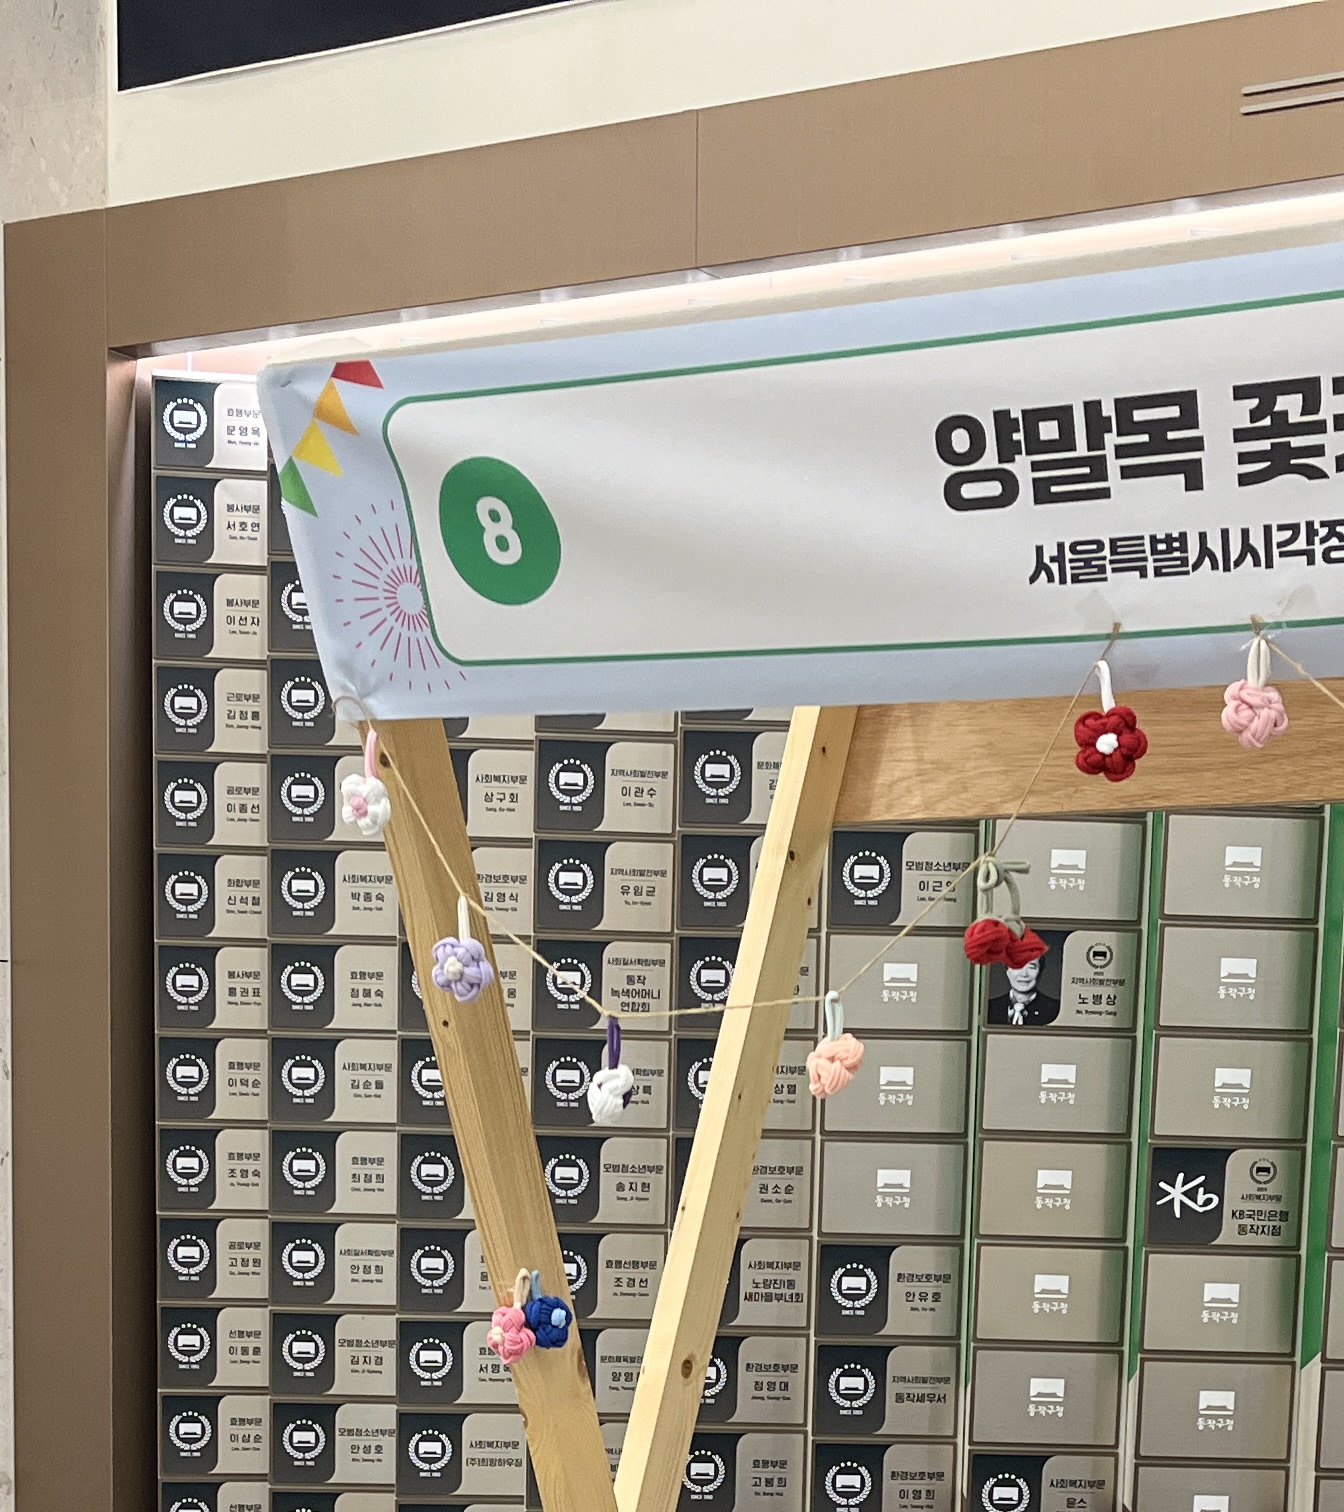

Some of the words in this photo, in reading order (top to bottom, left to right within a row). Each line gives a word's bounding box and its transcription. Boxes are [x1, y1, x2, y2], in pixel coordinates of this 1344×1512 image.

[934, 387, 1204, 513] 양말목
[475, 496, 523, 565] 8
[1222, 871, 1260, 888] 동작구청
[881, 990, 917, 1002] 동작구청
[1039, 1088, 1075, 1104] 동작구청
[1212, 1096, 1249, 1109] 동작구청
[875, 1195, 910, 1207] 동작구청
[1032, 1298, 1067, 1313] 동작구청
[611, 1372, 639, 1383] 양영
[1197, 1414, 1233, 1430] 동작구청
